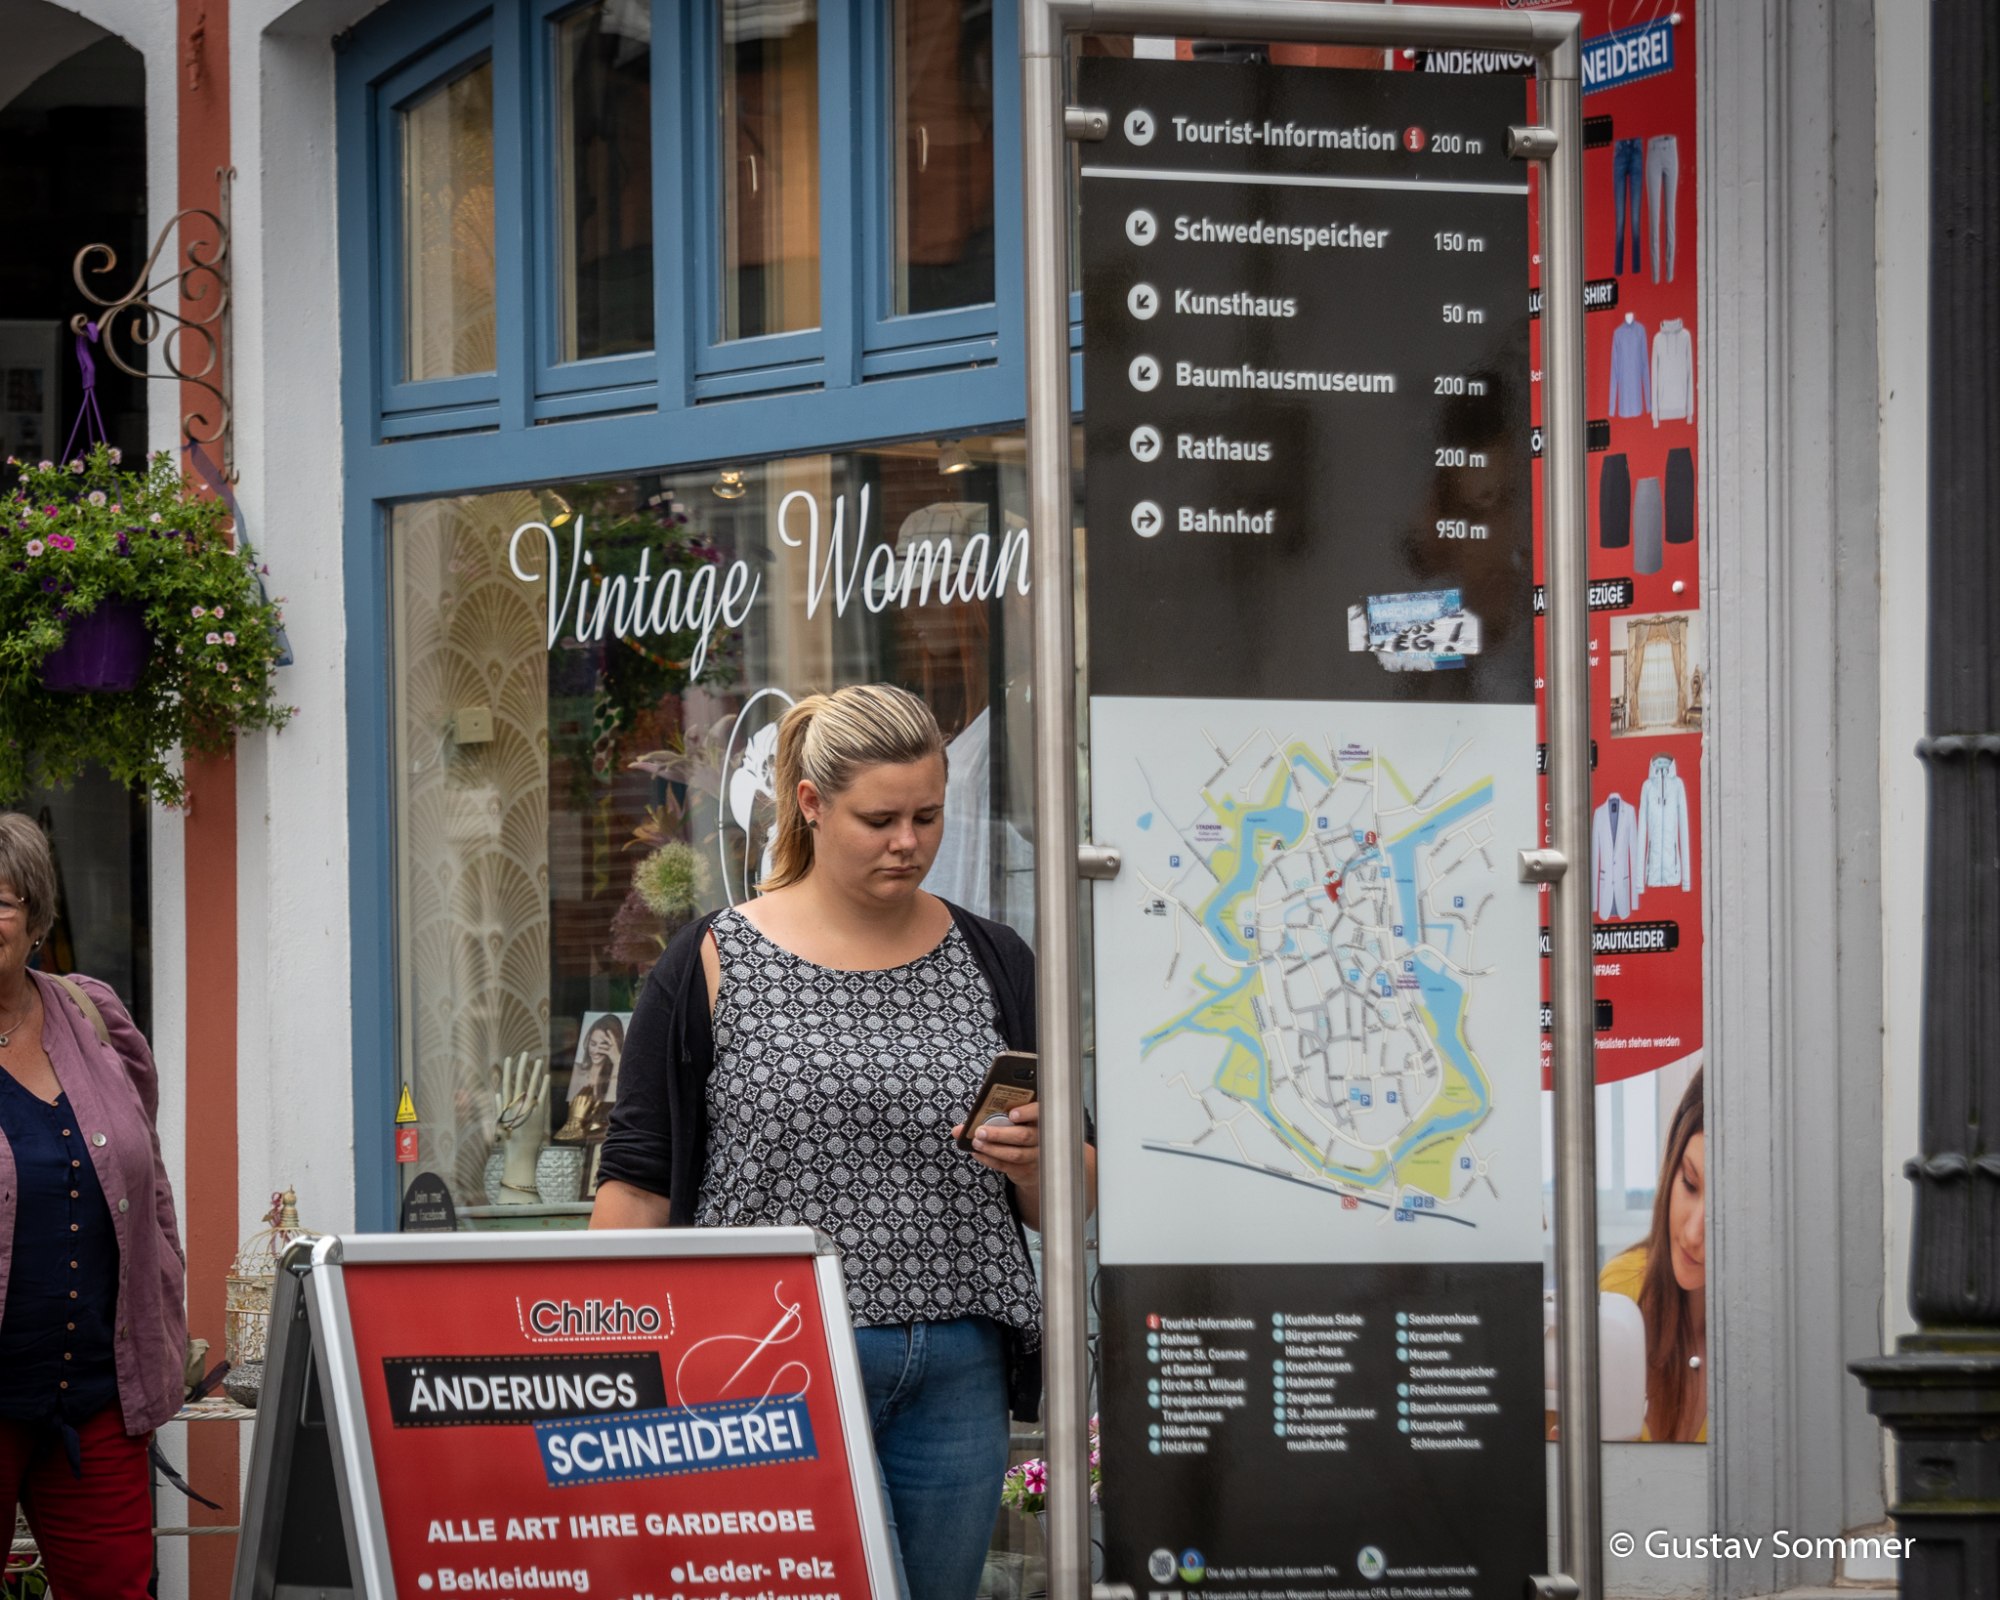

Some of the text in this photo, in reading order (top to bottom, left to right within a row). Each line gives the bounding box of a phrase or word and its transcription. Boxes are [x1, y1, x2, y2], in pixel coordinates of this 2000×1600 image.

[1172, 117, 1396, 151] Tourist-Information
[1431, 135, 1460, 153] 200
[1465, 139, 1482, 154] m
[1174, 217, 1483, 252] Schwedenspeicher 150 m
[1174, 289, 1483, 323] Kunsthaus 50 m
[1176, 362, 1484, 396] Baumhausmuseum 200 m
[1177, 435, 1485, 468] Rathaus 200 m
[1178, 508, 1486, 539] Bahnhof 950 m
[508, 482, 1031, 682] Vintage Woman
[530, 1300, 660, 1335] Chikho
[1285, 1314, 1364, 1326] Kunsthaus Stade
[1161, 1334, 1200, 1345] Rathaus
[1409, 1350, 1450, 1361] Museum
[410, 1368, 637, 1413] ÄNDERUNGS
[1286, 1392, 1333, 1406] Zeughaus
[1410, 1403, 1499, 1414] Baumhausmuseum
[547, 1409, 802, 1475] SCHNEIDEREI
[428, 1509, 815, 1543] ALLE ART IHRE GARDEROBE
[437, 1566, 589, 1593] Bekleidung
[687, 1557, 835, 1583] Leder- Pelz
